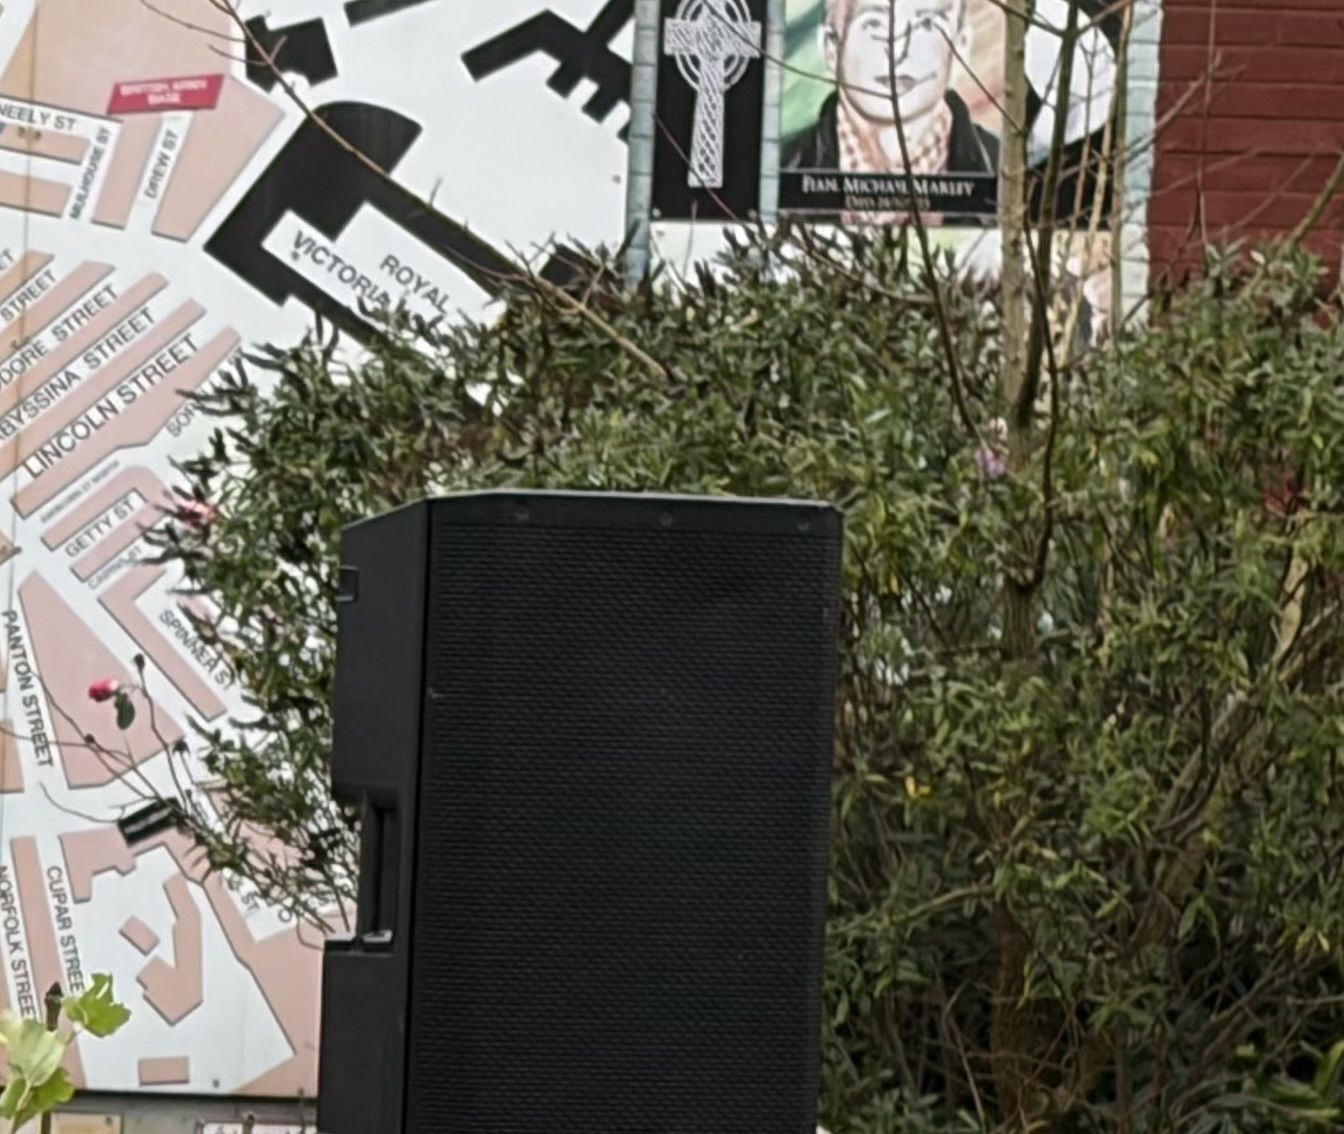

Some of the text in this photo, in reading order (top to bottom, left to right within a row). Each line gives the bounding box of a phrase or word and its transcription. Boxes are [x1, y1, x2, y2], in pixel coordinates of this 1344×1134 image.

[52, 113, 77, 132] ST
[0, 268, 57, 322] STREET
[292, 229, 453, 316] VICTORIA ROYAL
[52, 283, 119, 343] STREET
[85, 307, 156, 368] STREET
[23, 332, 201, 480] LINCOLN STREET
[2, 609, 54, 769] PANTON STREET
[46, 866, 86, 991] CUPAR STREE
[10, 959, 38, 1018] STREE
